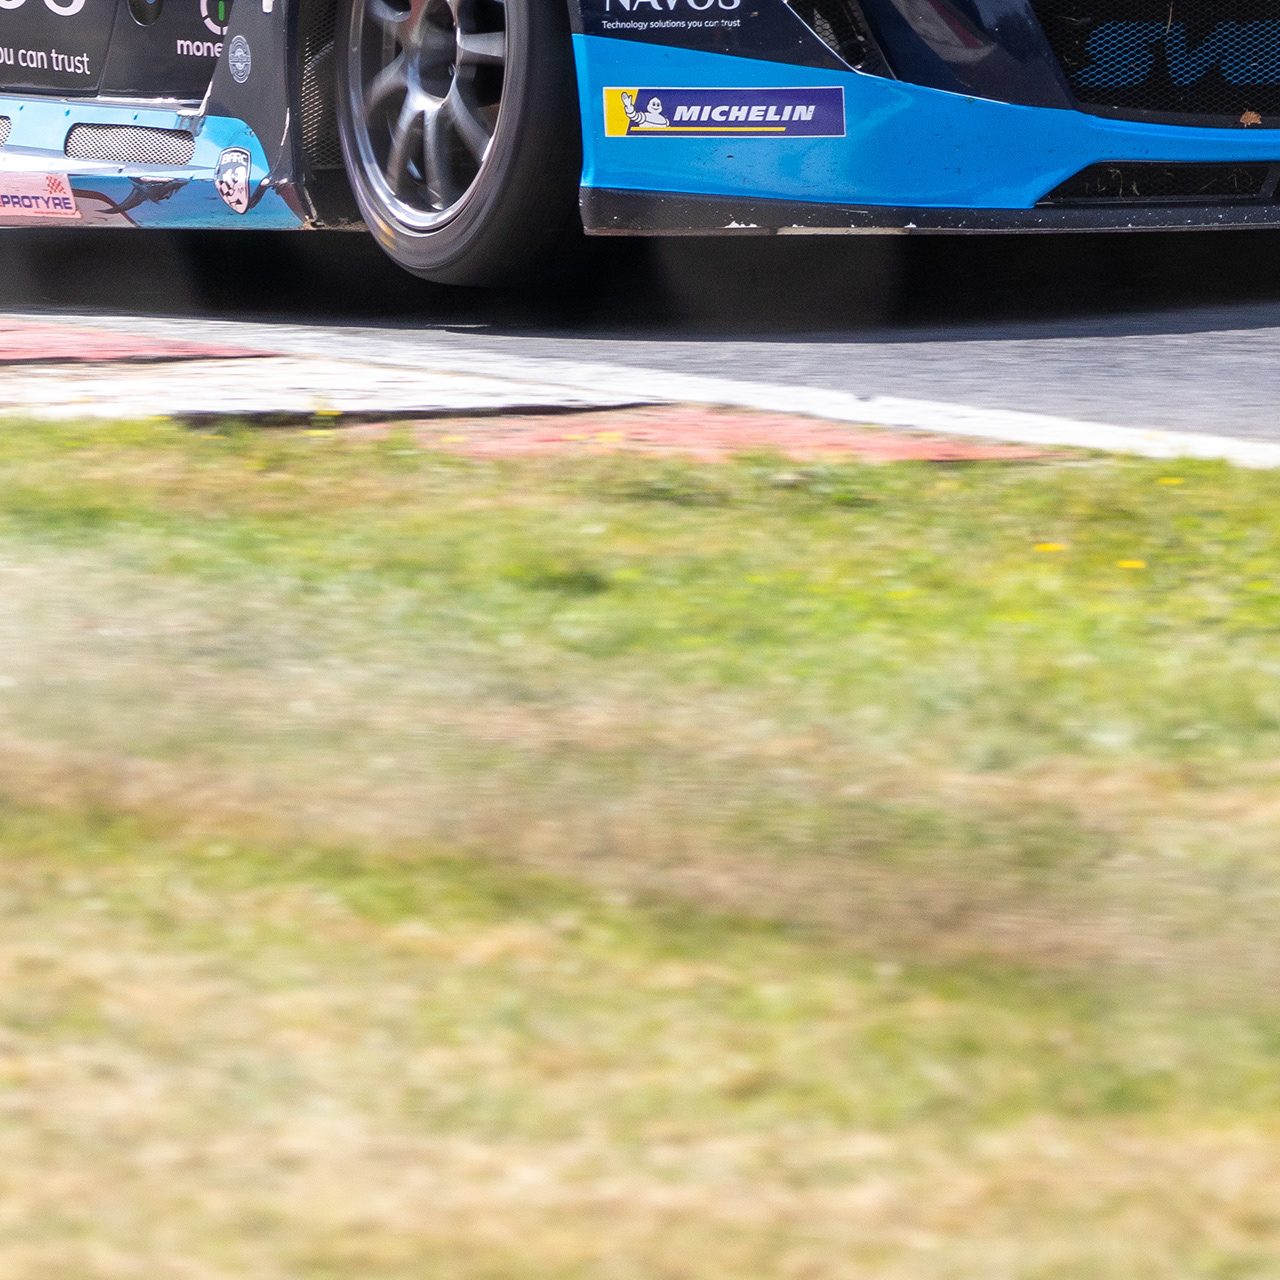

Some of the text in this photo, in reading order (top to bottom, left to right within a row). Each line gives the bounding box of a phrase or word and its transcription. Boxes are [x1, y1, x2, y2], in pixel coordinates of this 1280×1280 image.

[602, 20, 648, 30] Technology
[650, 19, 686, 28] solutions
[687, 20, 703, 30] you
[18, 47, 47, 69] can
[51, 49, 91, 75] trust
[673, 105, 816, 122] MICHELIN
[221, 151, 249, 165] BARC
[0, 194, 73, 210] PROTYRE
